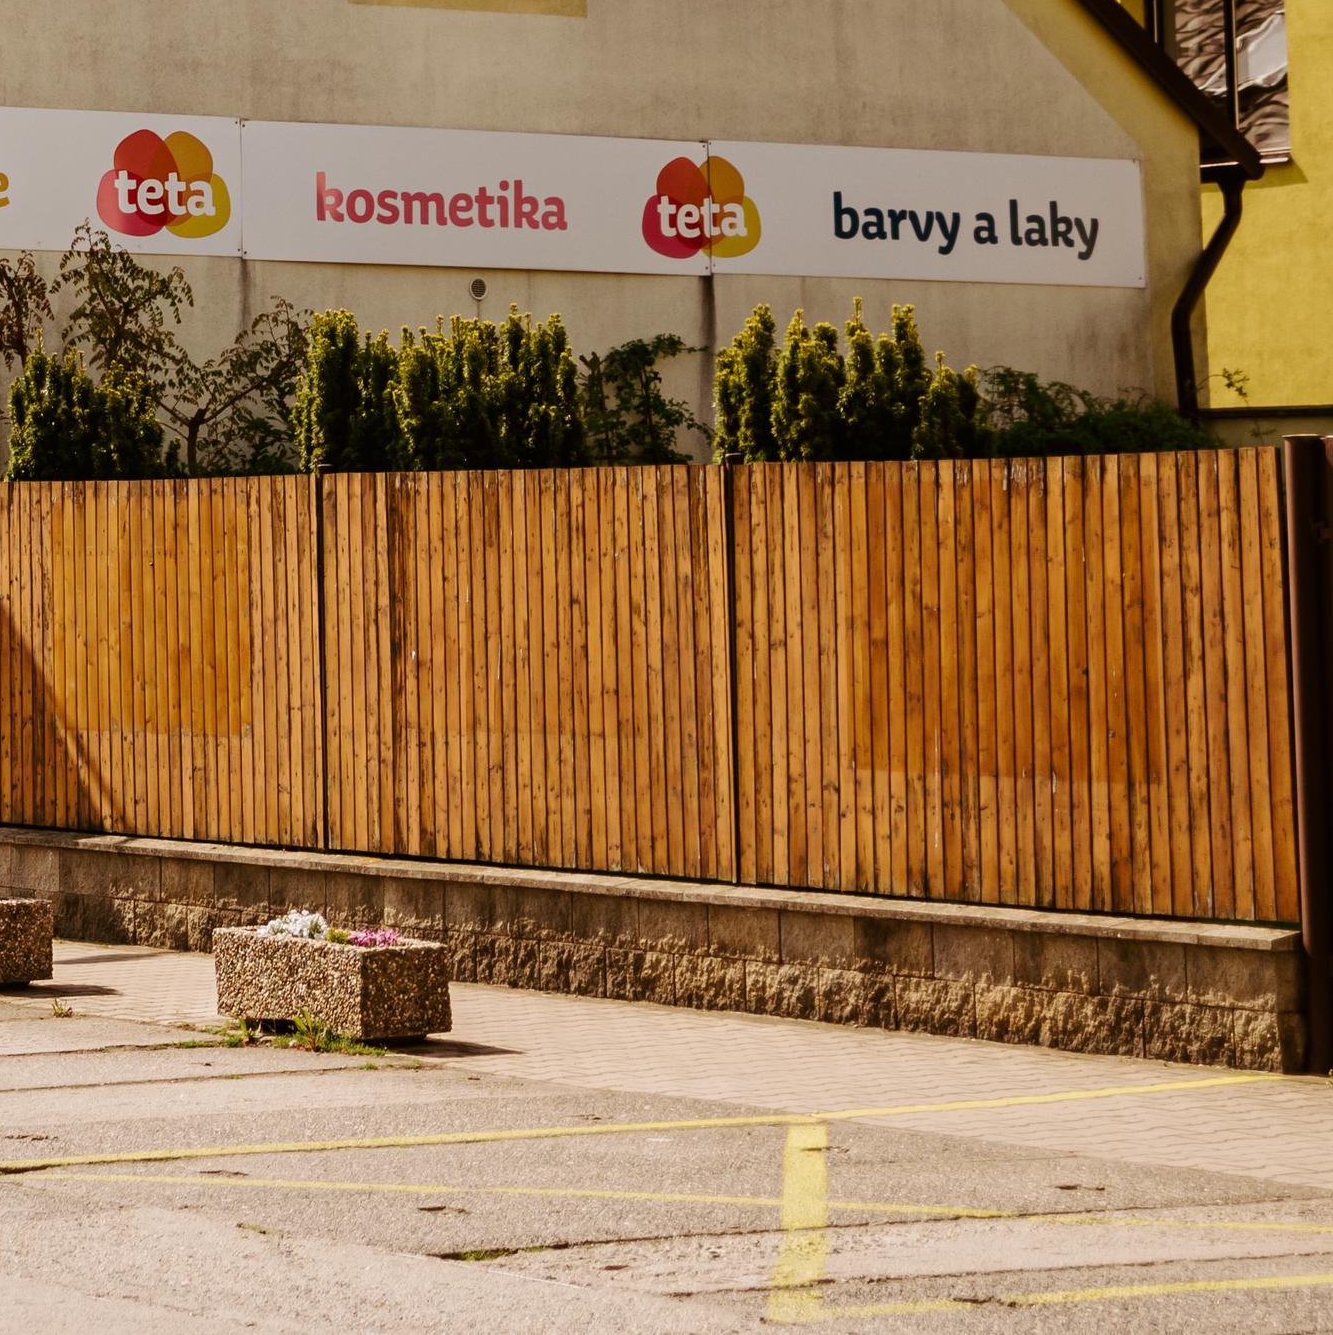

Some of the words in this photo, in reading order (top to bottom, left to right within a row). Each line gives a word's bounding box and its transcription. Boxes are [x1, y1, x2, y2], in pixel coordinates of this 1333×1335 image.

[114, 170, 216, 216] teta
[316, 173, 568, 231] kosmetika
[657, 195, 748, 239] teta
[833, 190, 961, 256] barvy
[973, 211, 999, 245] a
[1009, 198, 1099, 261] laky
